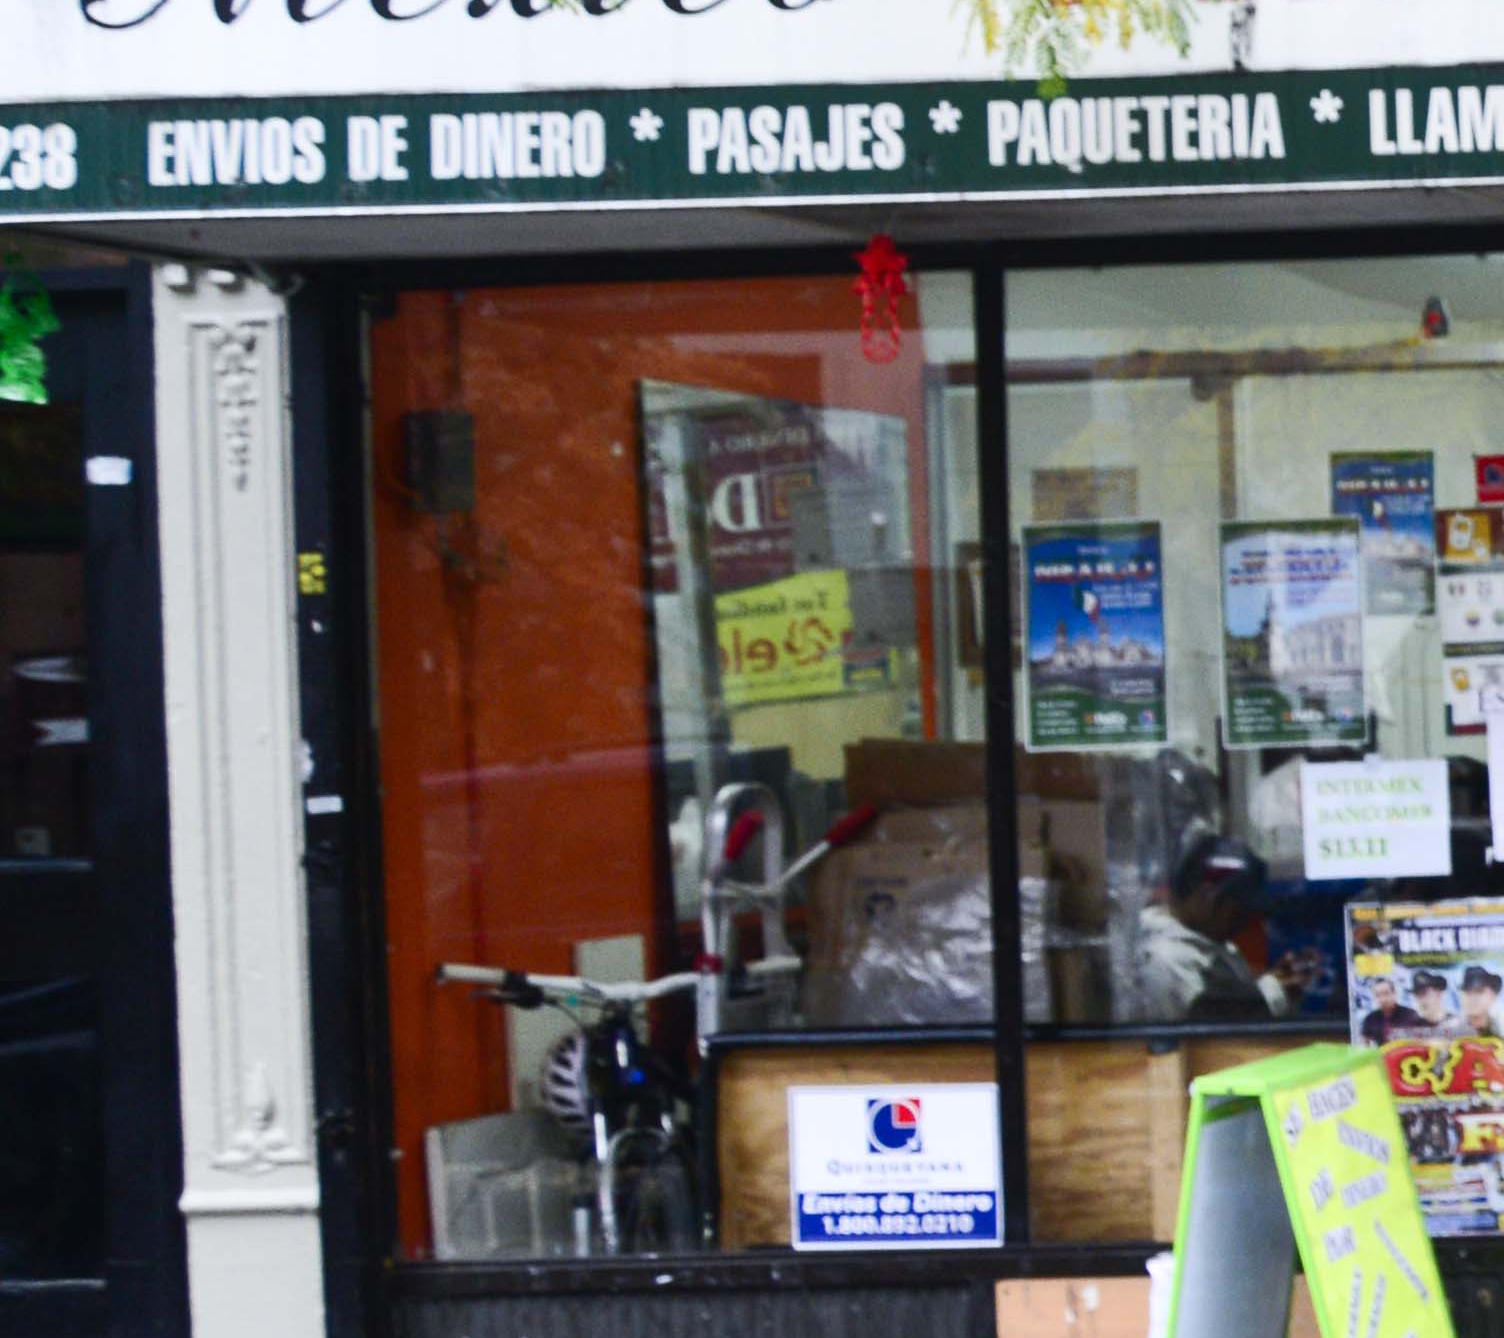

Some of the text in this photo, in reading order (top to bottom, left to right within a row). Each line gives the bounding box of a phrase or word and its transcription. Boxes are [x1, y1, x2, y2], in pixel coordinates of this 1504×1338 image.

[147, 115, 325, 186] ENVIOS
[348, 114, 407, 182] DE
[429, 108, 606, 181] DINERO
[688, 102, 906, 175] PASAJES
[987, 91, 1284, 173] PAQUETERIA
